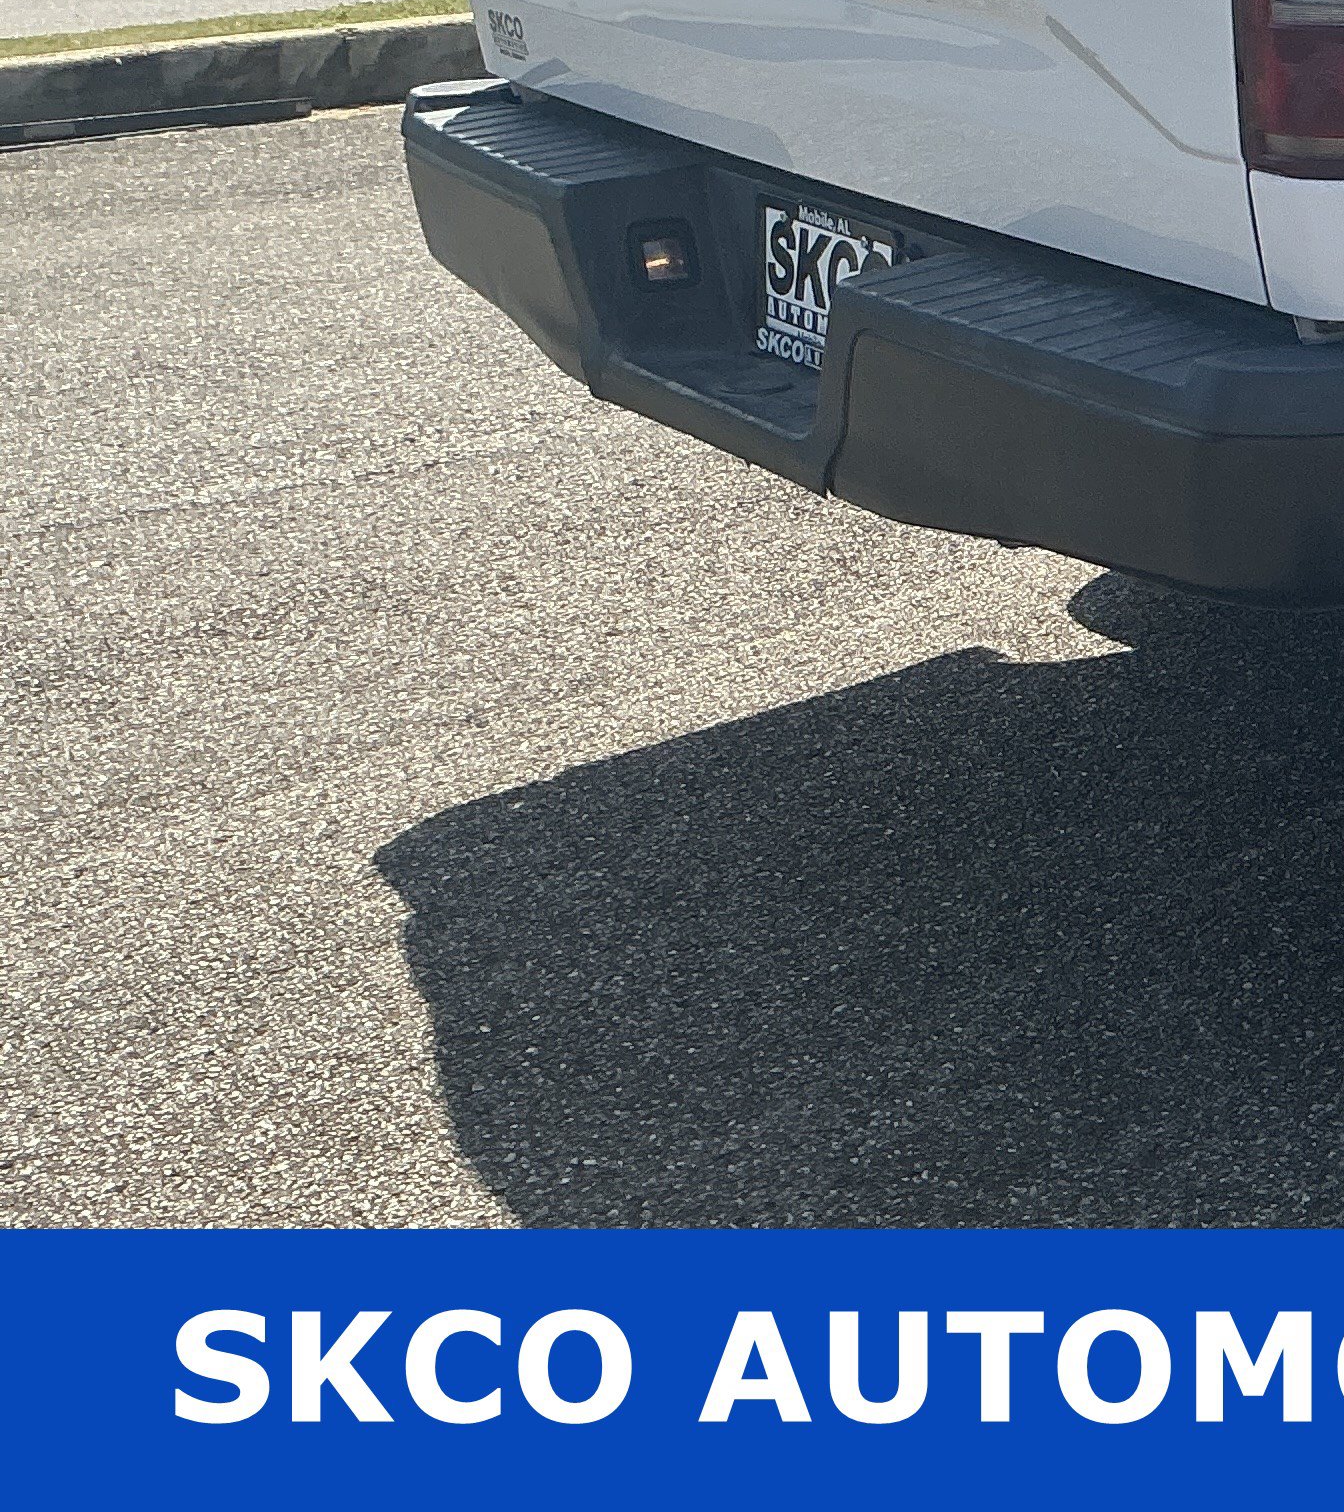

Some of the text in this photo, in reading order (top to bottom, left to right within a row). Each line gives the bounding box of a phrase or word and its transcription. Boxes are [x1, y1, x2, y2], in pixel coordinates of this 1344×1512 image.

[488, 9, 524, 40] SKCO
[767, 296, 829, 336] AUTOM
[756, 327, 805, 364] SKCO
